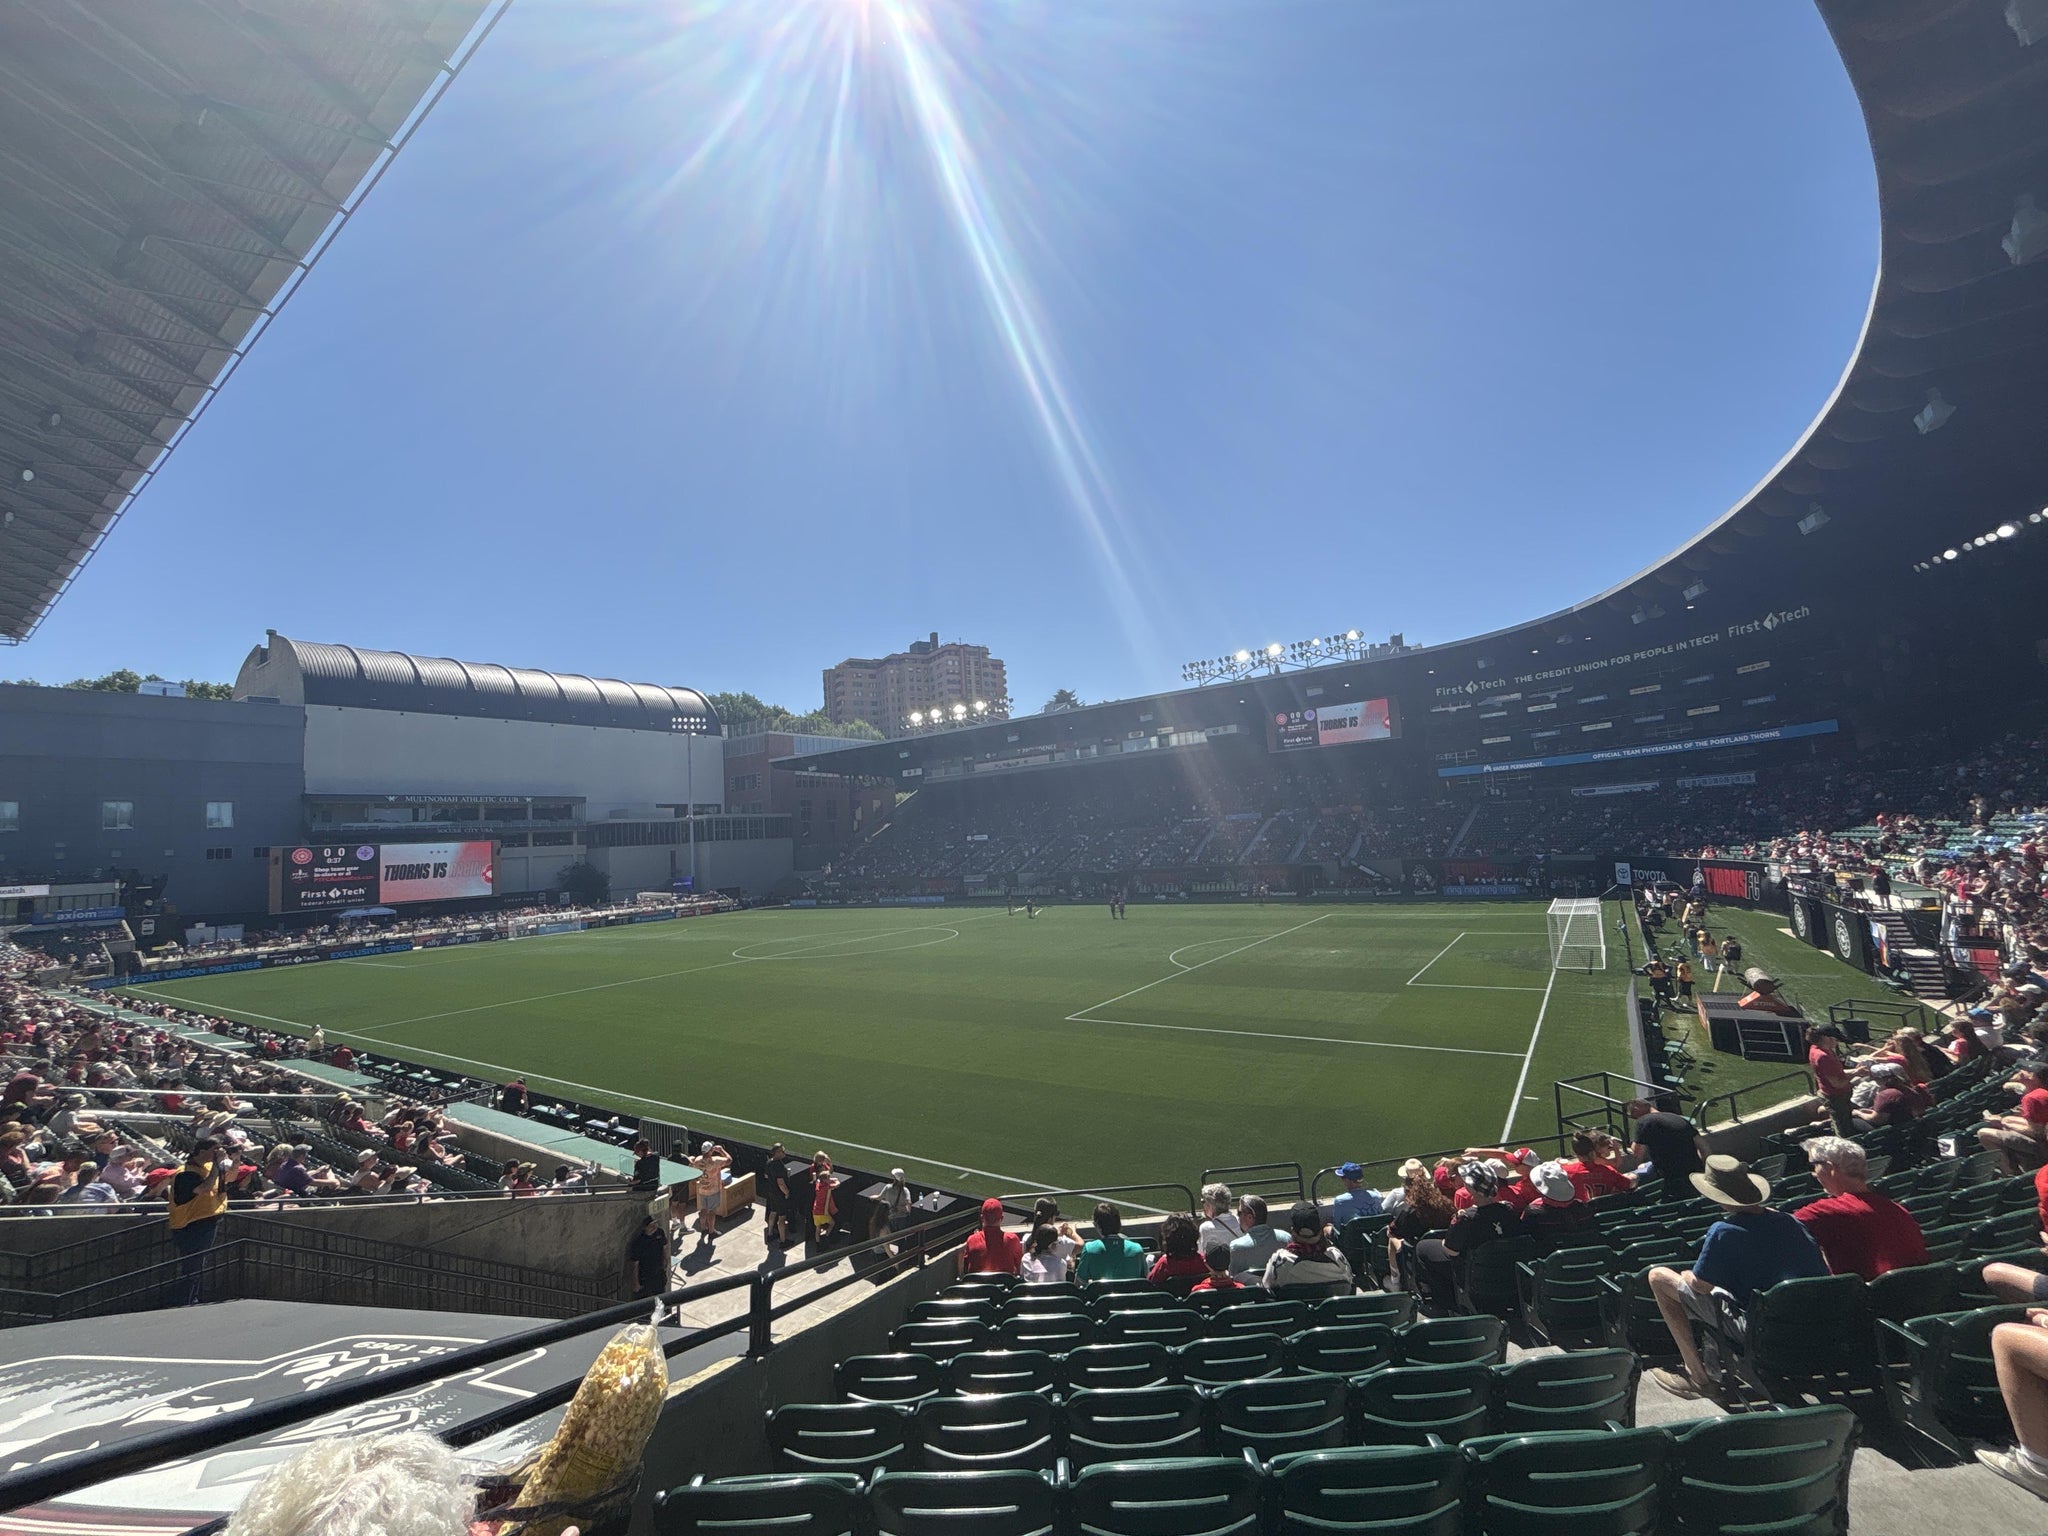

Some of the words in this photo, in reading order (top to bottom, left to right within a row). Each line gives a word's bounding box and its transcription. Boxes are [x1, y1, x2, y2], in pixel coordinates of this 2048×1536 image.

[1728, 619, 1760, 638] First
[1779, 606, 1810, 623] Tech
[1514, 674, 1533, 684] THE
[1535, 667, 1572, 680] CREDIT
[1574, 660, 1608, 673] UNION
[1610, 654, 1631, 666] FOR
[1634, 644, 1674, 661] PEOPLE
[1676, 641, 1688, 651] IN
[1689, 633, 1719, 648] TECH
[1436, 685, 1463, 696] First
[1479, 678, 1506, 690] Tech
[1320, 717, 1348, 731] THORNS
[1348, 716, 1358, 727] VS
[1622, 748, 1641, 756] TEAM
[1642, 744, 1682, 754] PHYSICIANS
[1710, 735, 1749, 745] PORTLAND
[1751, 730, 1780, 740] THORNS
[324, 848, 331, 857] 0
[338, 847, 346, 857] 0
[384, 862, 430, 881] THORNS
[432, 862, 448, 878] VS
[1632, 869, 1667, 881] TOYOTA
[1704, 867, 1745, 898] THORNS
[1744, 870, 1760, 901] FC
[301, 890, 327, 899] First
[341, 888, 365, 896] Tech
[56, 911, 97, 920] axiom
[502, 930, 531, 938] DLTA
[330, 946, 383, 960] EXCLUSIVE
[165, 966, 205, 979] UNION
[208, 961, 262, 974] PARTNER
